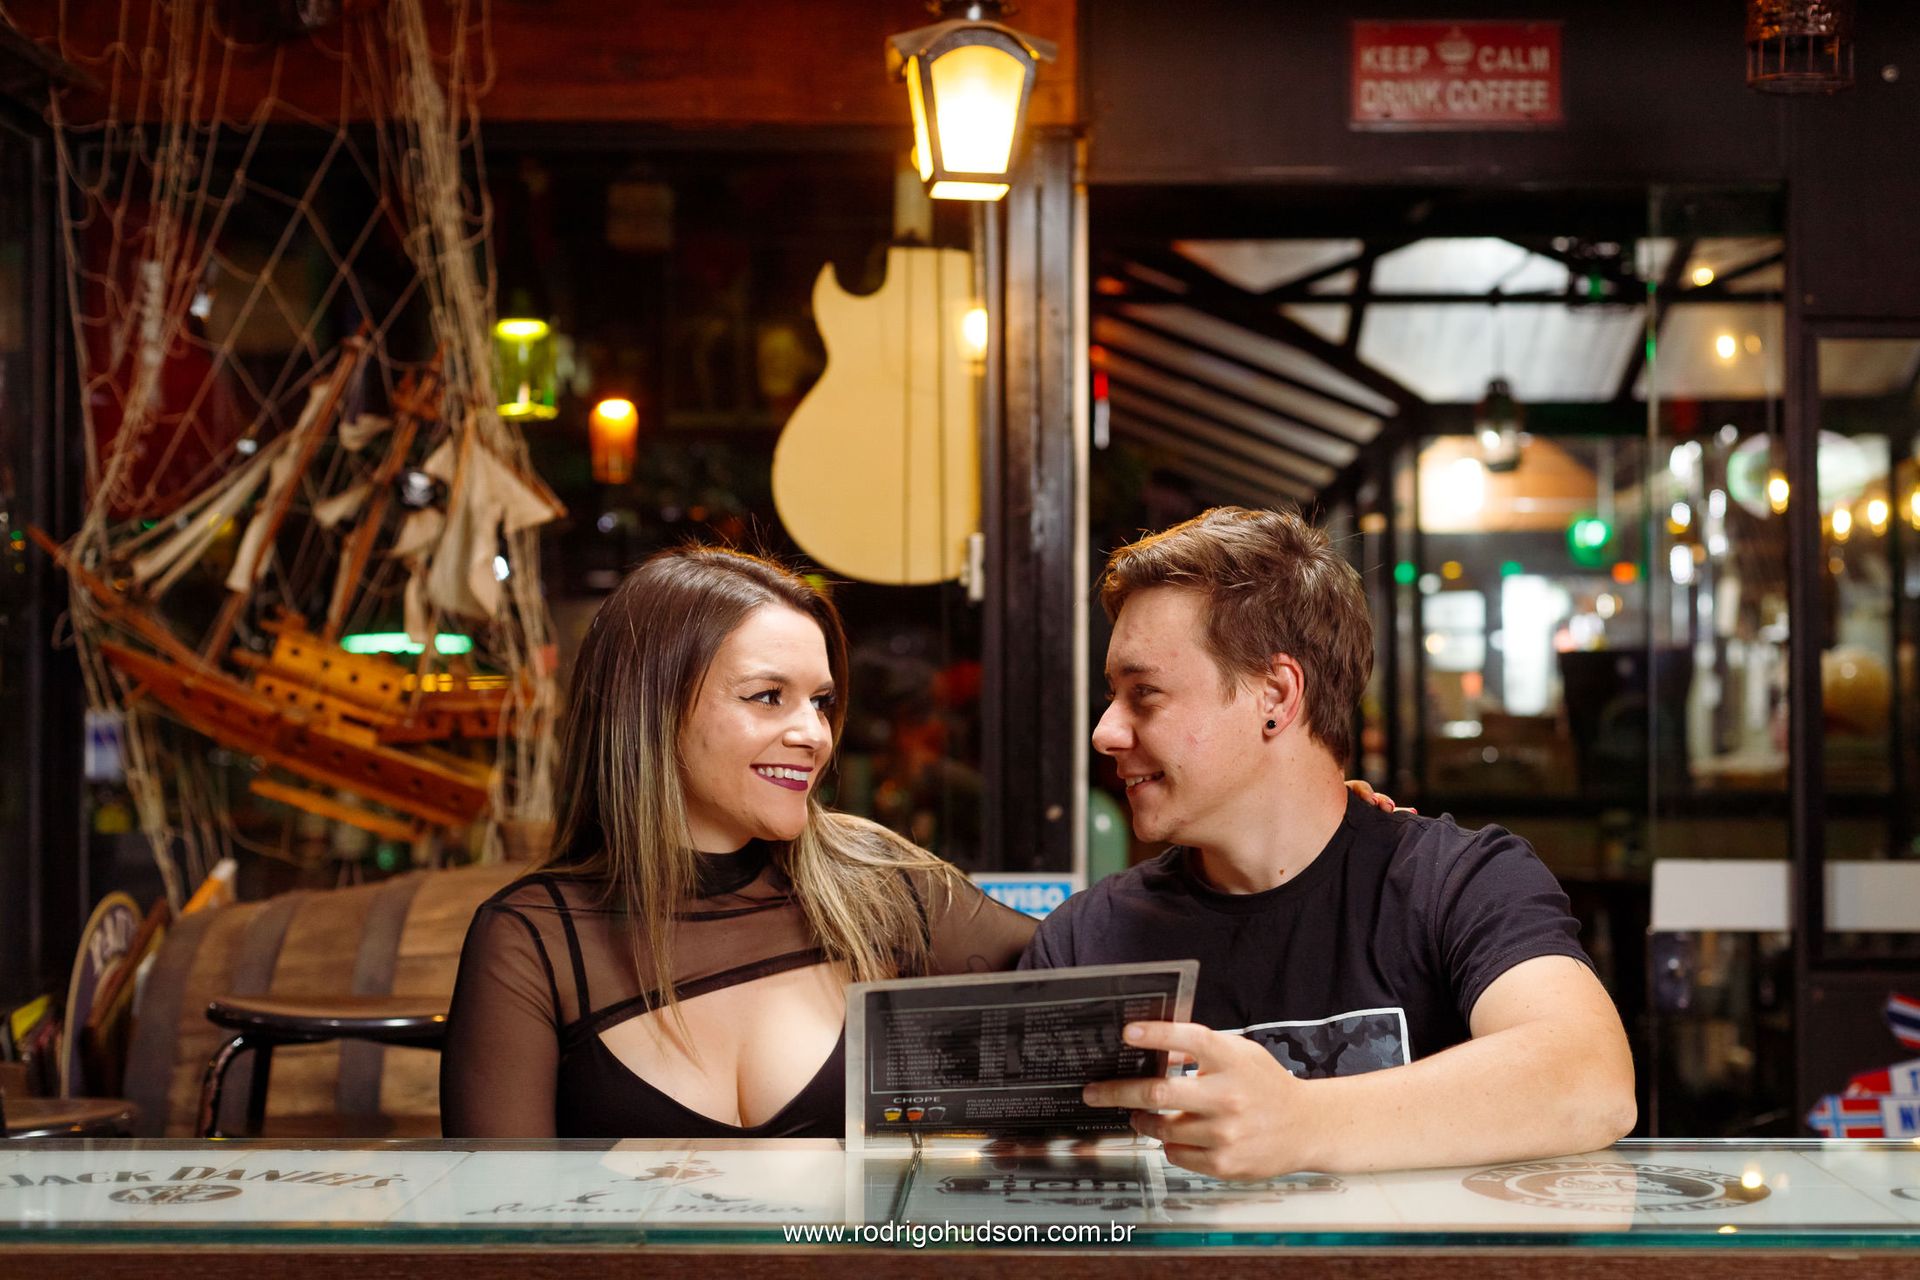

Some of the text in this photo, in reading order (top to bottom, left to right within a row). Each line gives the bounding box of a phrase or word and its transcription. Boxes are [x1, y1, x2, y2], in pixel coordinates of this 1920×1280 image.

[1360, 46, 1549, 73] KEEP CALM
[1360, 79, 1548, 112] DRINK COFFEE
[893, 1096, 941, 1104] CHOPE
[0, 1170, 154, 1187] JACK
[1469, 1163, 1740, 1182] PAULANER
